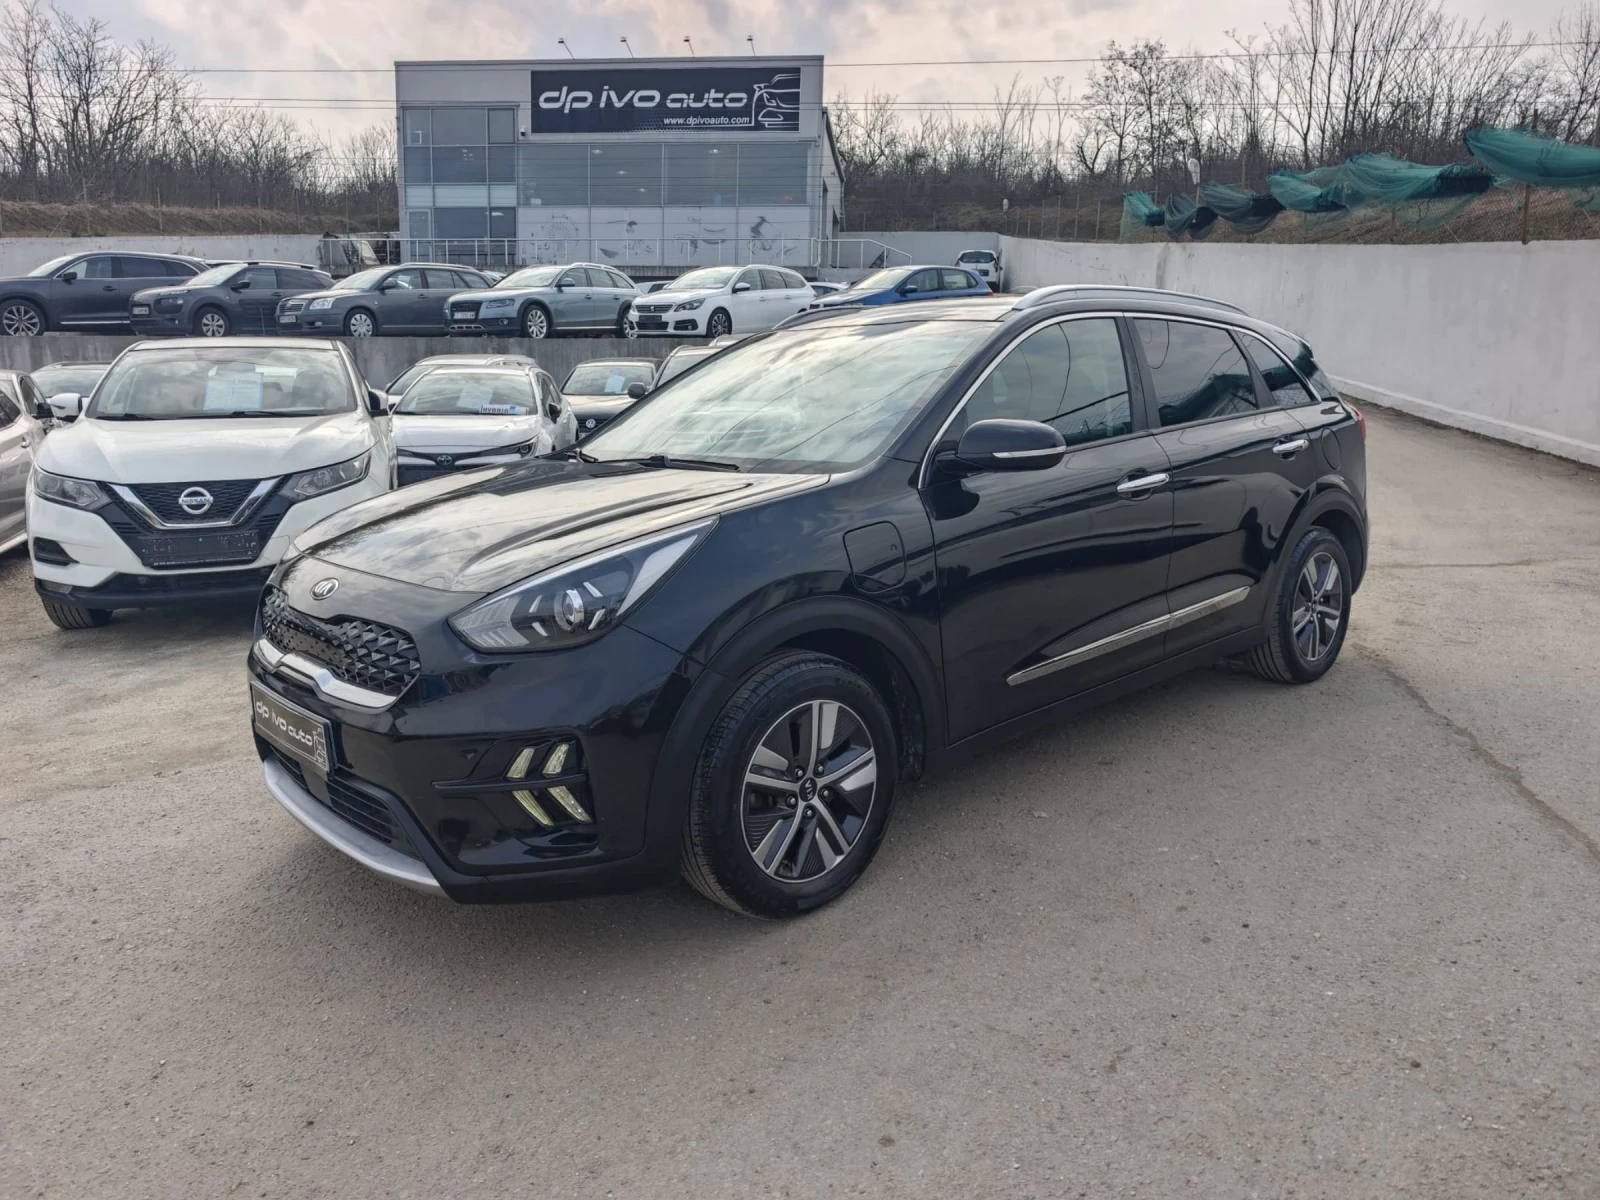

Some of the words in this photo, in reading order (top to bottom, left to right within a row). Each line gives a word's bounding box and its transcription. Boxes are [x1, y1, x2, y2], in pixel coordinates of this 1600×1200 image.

[538, 86, 593, 113] dp
[599, 85, 661, 108] ivo
[666, 88, 748, 108] auto
[663, 116, 750, 125] www.dpivoauto.com
[256, 701, 269, 718] dp
[271, 709, 287, 731] ivo
[287, 725, 313, 746] auto
